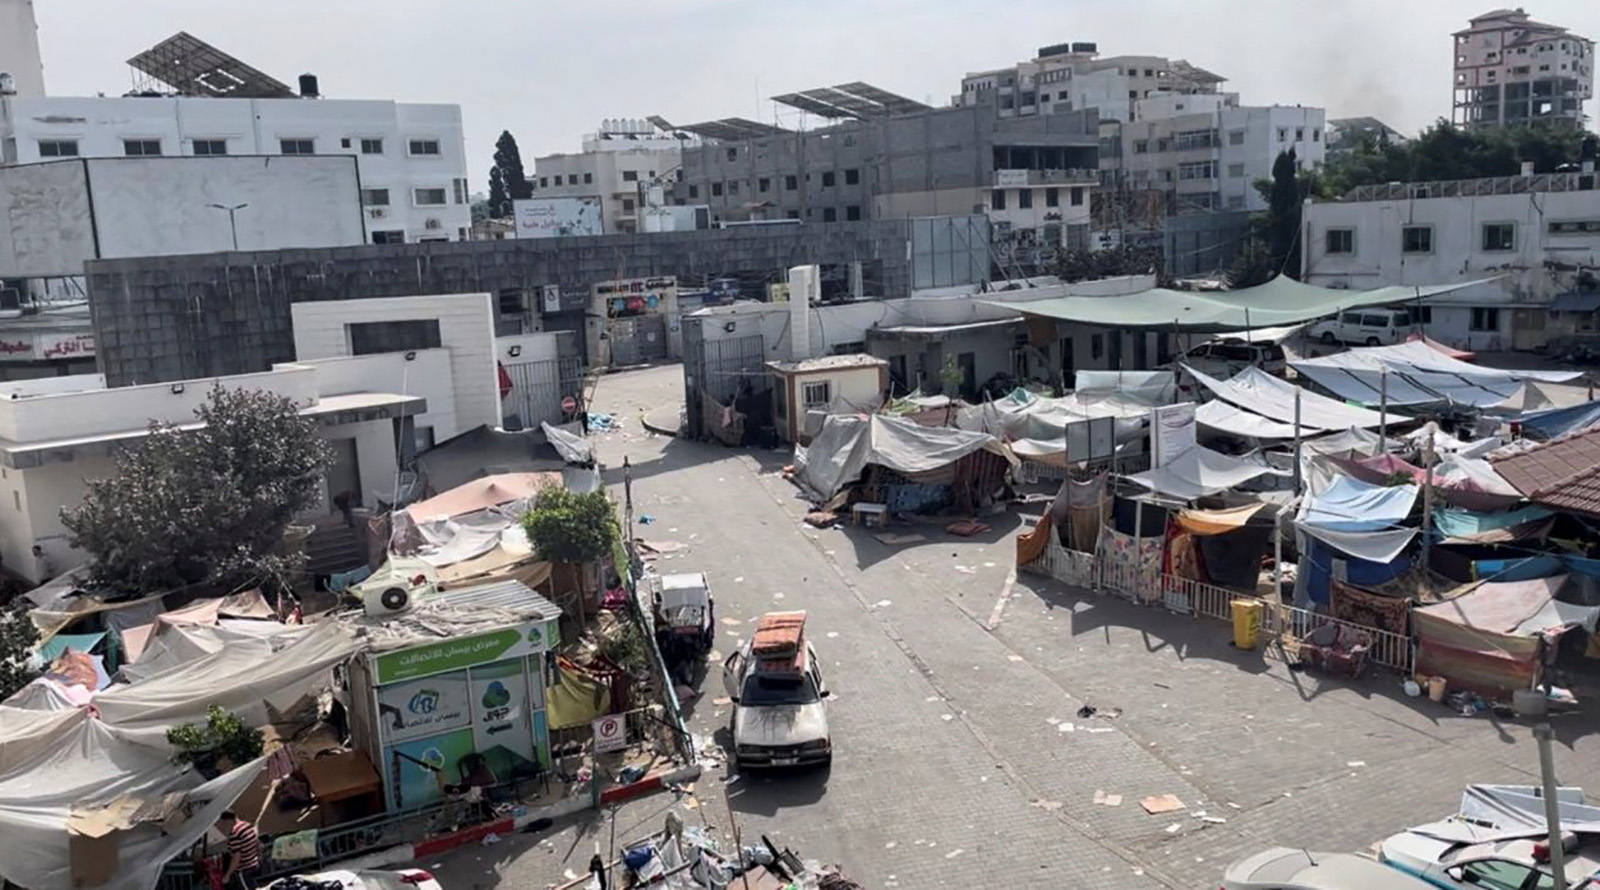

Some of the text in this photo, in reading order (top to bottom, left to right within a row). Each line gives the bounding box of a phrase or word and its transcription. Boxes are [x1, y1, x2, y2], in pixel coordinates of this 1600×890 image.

[400, 639, 500, 666] معرض بيسان للاتصالات
[482, 707, 510, 722] جوال
